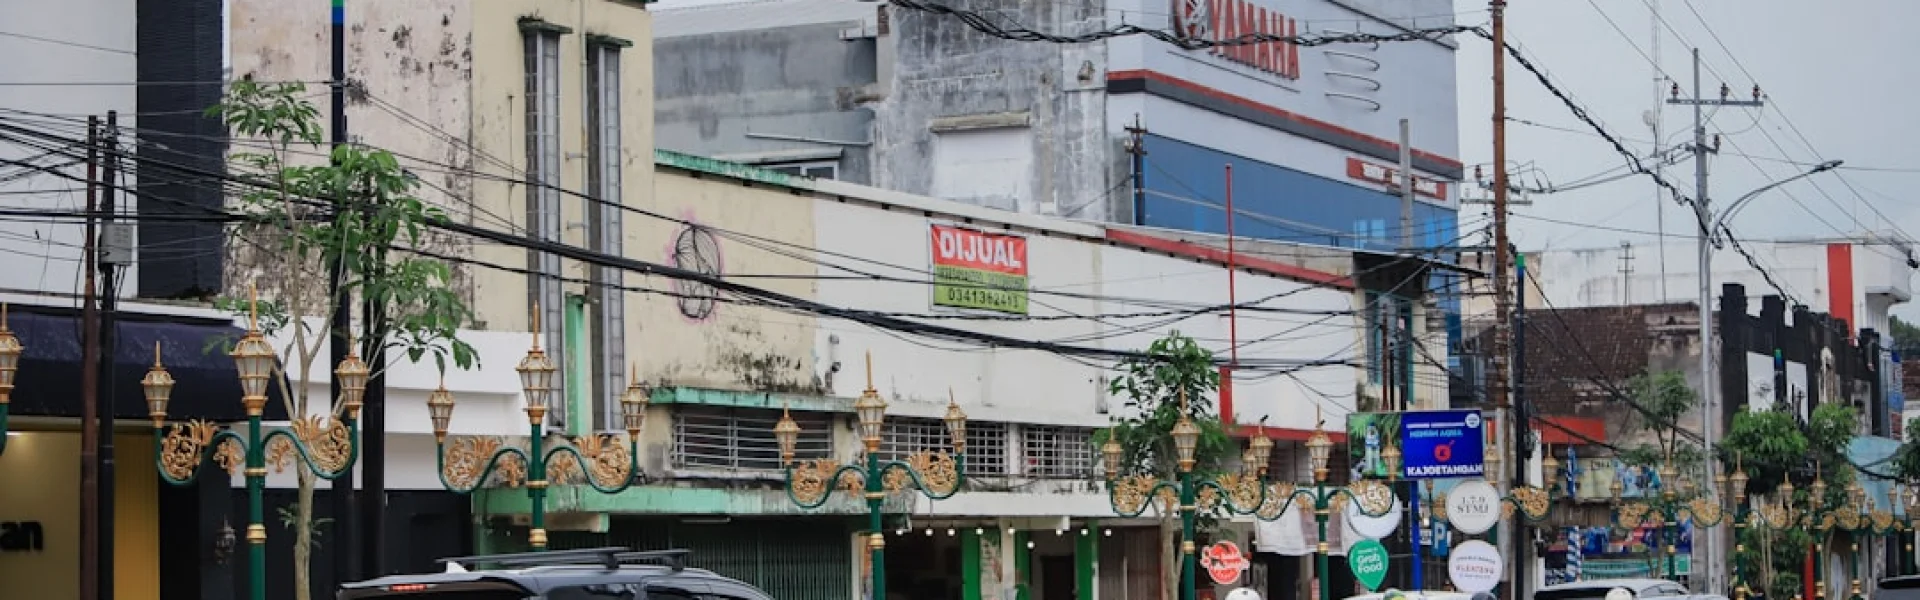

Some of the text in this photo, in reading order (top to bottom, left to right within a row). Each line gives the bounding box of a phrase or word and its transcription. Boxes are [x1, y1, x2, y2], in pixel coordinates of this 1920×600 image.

[1208, 0, 1299, 80] YAMAHA
[940, 231, 1021, 268] DIJUAL
[1434, 522, 1446, 550] P
[1356, 553, 1381, 563] Grab
[1358, 561, 1383, 574] Food
